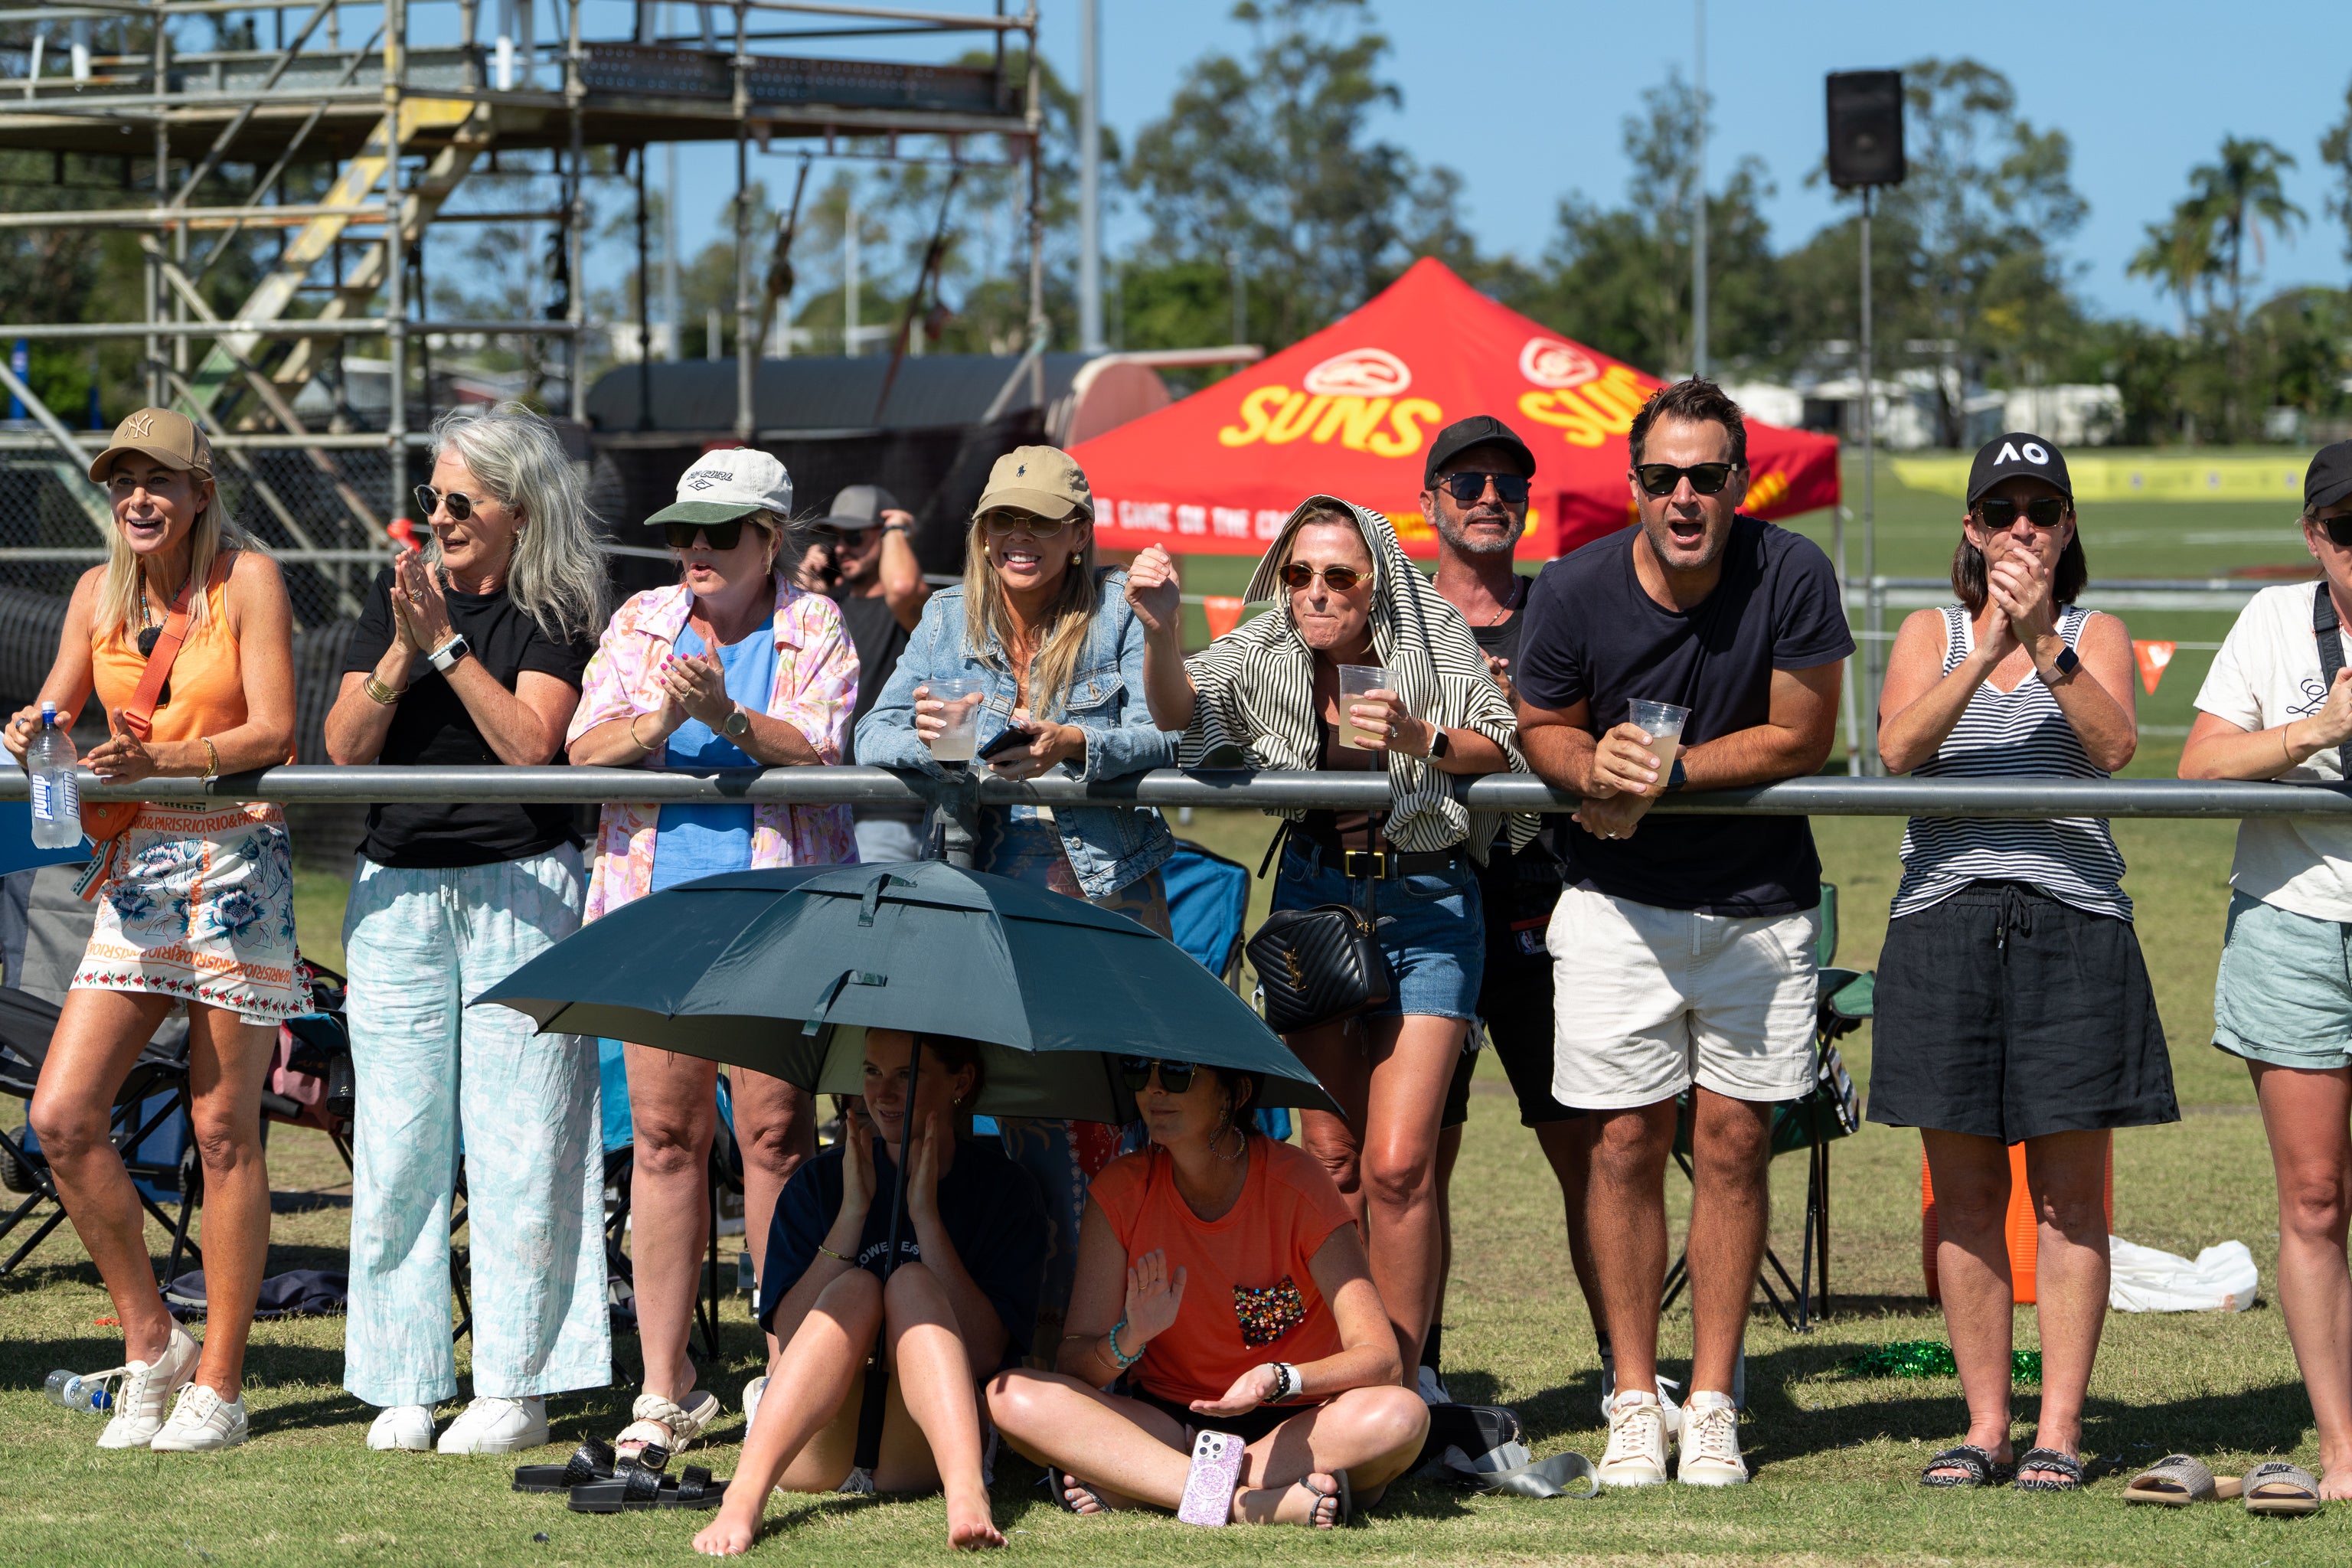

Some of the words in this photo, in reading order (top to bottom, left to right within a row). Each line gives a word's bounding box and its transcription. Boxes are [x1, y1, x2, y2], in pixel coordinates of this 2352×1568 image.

[1219, 385, 1443, 457] SUNS
[1994, 442, 2050, 466] AO
[701, 470, 733, 481] CURL
[858, 1242, 888, 1264] OWE
[2262, 1463, 2294, 1472] NIKE
